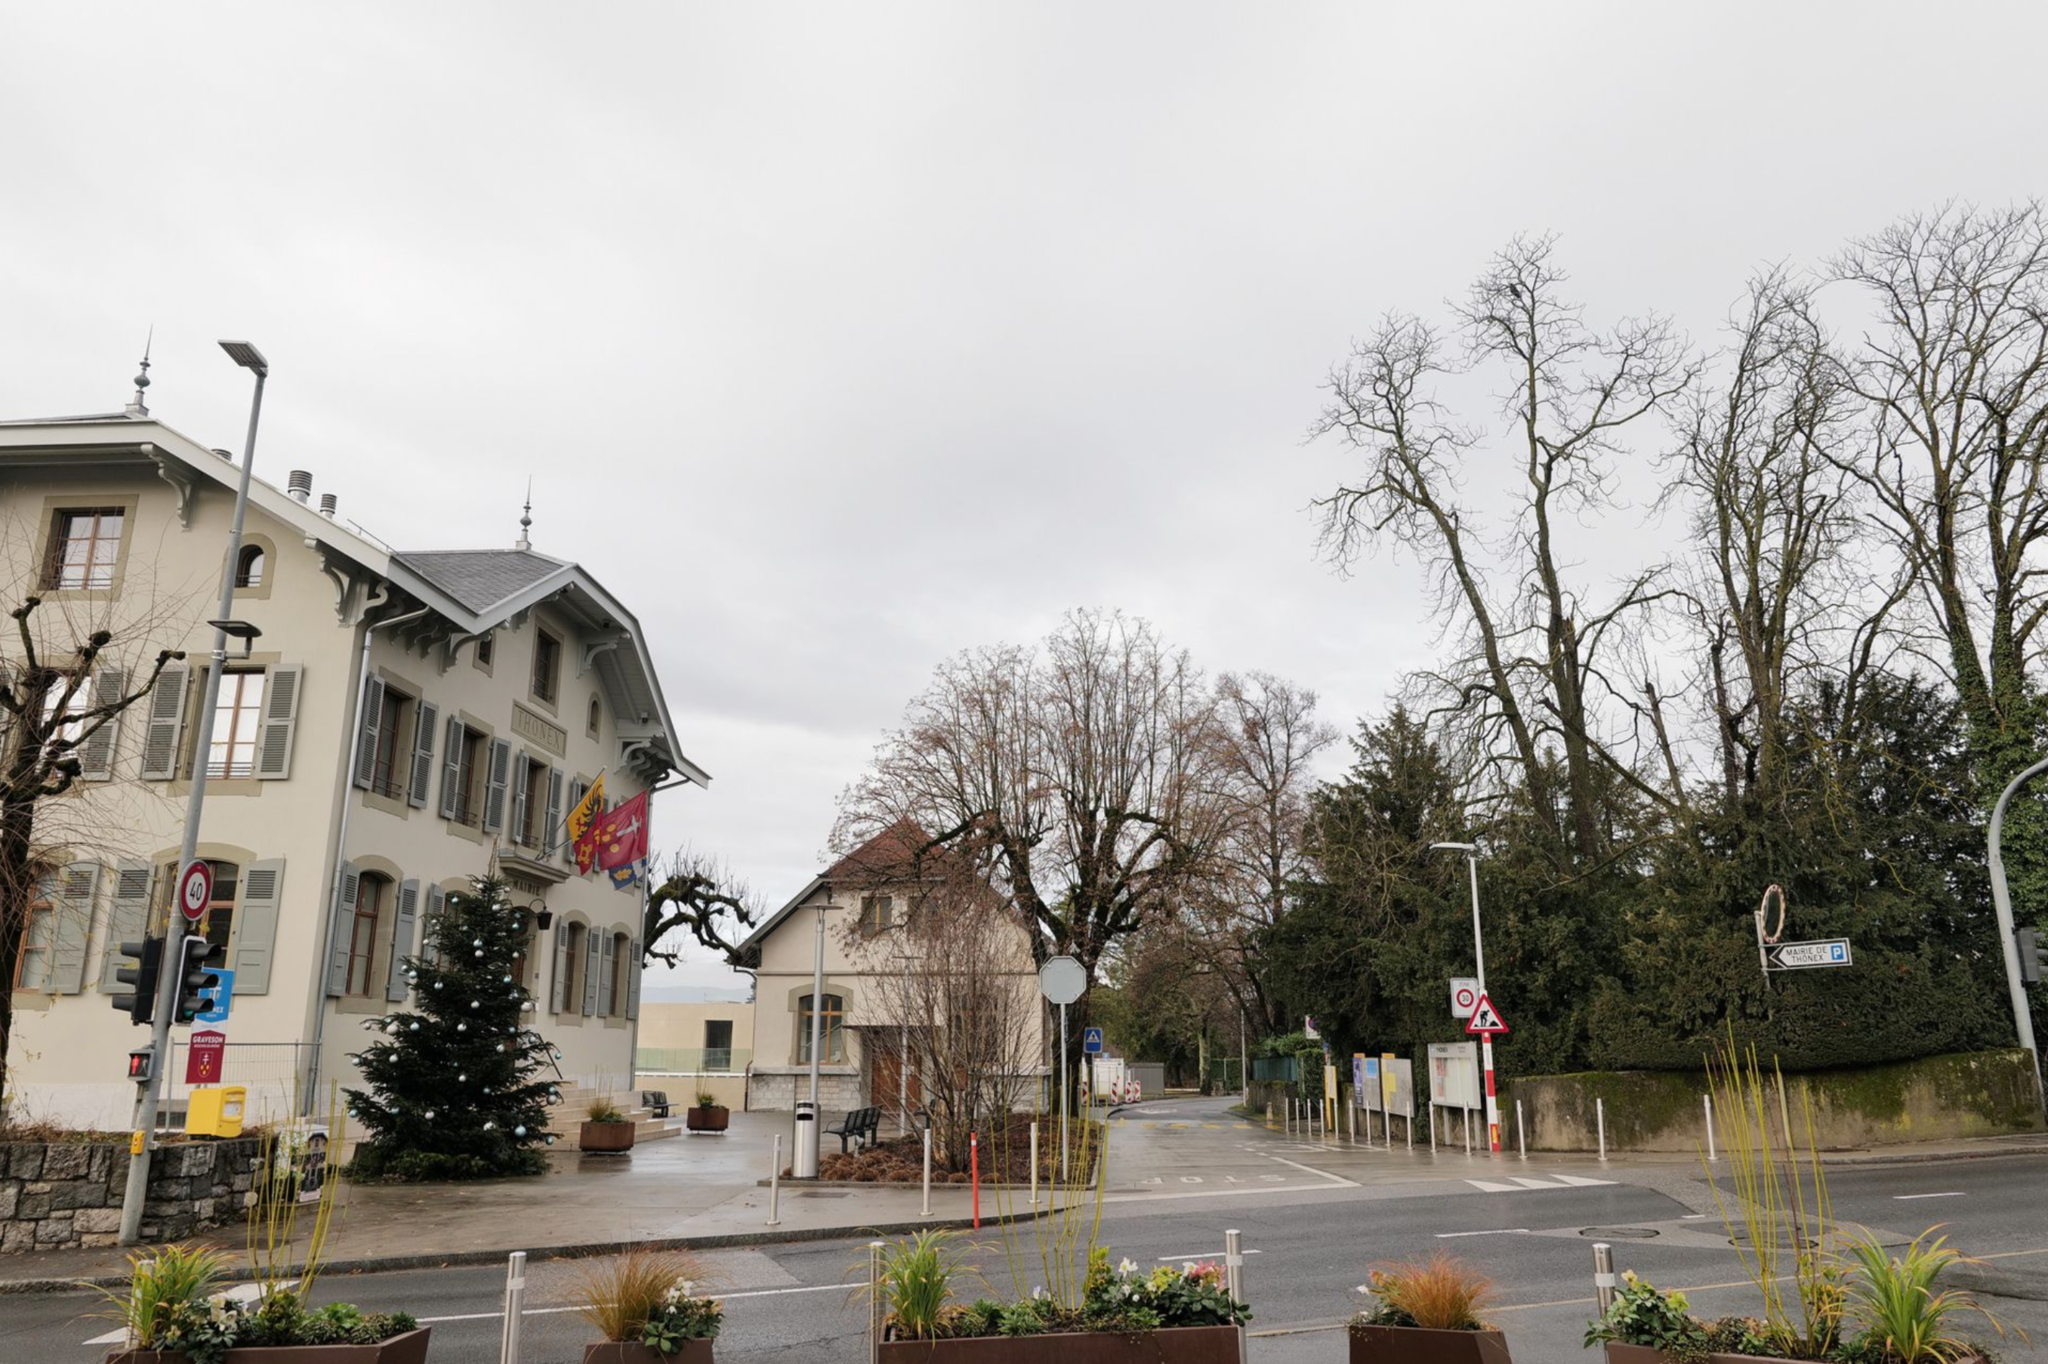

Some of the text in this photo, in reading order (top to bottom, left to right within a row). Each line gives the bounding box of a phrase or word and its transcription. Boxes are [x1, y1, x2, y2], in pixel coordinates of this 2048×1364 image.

[190, 882, 203, 901] 40
[513, 880, 540, 896] MAIRIE
[1786, 946, 1827, 956] MAIRIE DE
[1461, 994, 1470, 1002] 30
[192, 1035, 224, 1044] GRAVESON
[1140, 1174, 1286, 1185] STOP
